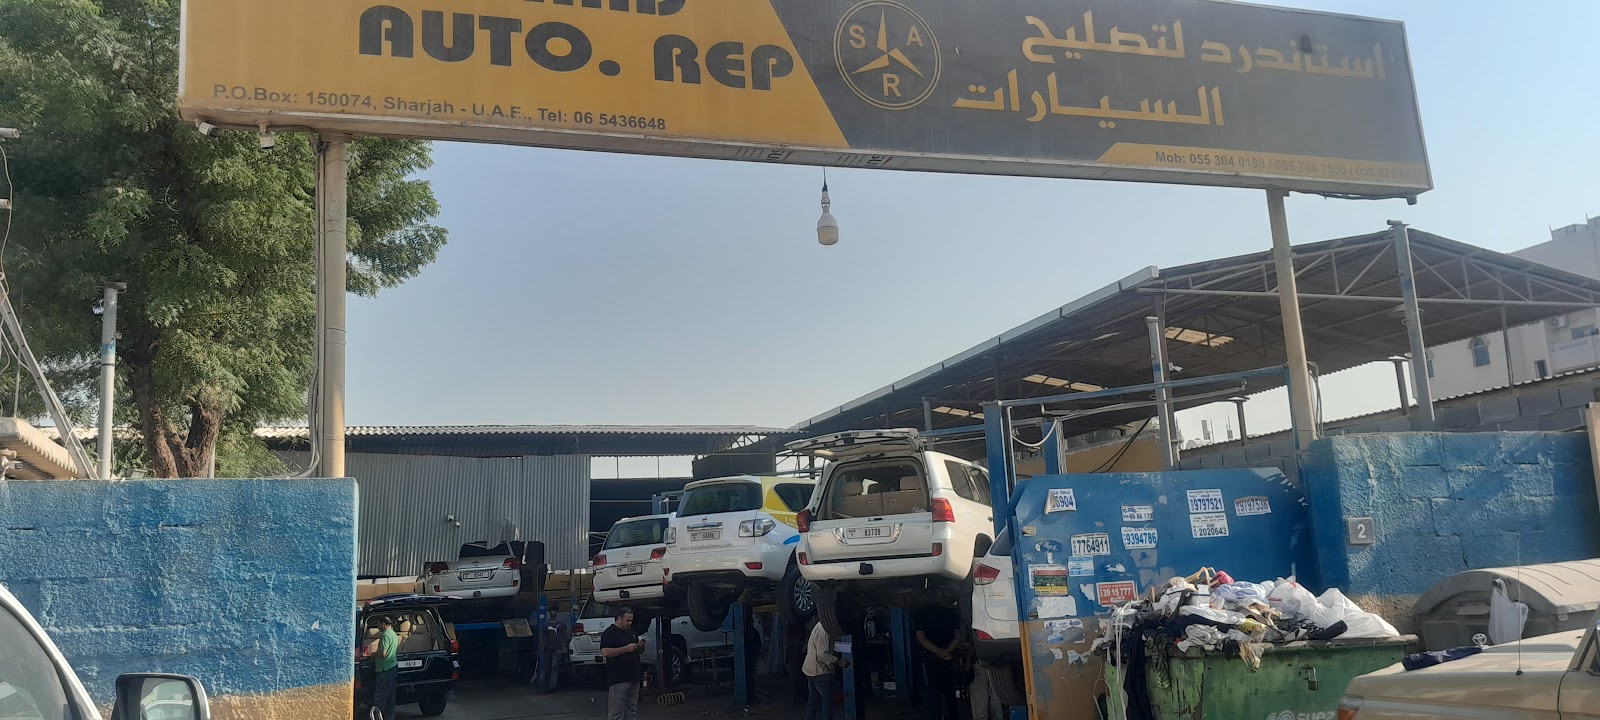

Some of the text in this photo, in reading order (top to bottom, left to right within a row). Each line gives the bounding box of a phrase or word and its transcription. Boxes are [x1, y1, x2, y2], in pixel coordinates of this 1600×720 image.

[1021, 9, 1185, 64] لتصليح
[359, 5, 794, 90] AUTO. REP
[213, 84, 298, 104] P.O.Box:
[306, 91, 377, 111] 150074,
[383, 96, 454, 116] Sharjah
[537, 107, 567, 122] Tel:
[574, 111, 593, 125] 06
[599, 113, 666, 130] 5436648
[1155, 152, 1185, 164] Mob:
[1190, 154, 1211, 165] 055
[1214, 155, 1235, 167] 304
[1276, 160, 1296, 171] 055
[1193, 498, 1223, 511] 9797521
[1126, 532, 1157, 545] 9394786
[1199, 527, 1227, 537] 2020643
[1357, 523, 1367, 539] 2
[1077, 538, 1109, 554] 7764911
[1120, 587, 1131, 596] 777
